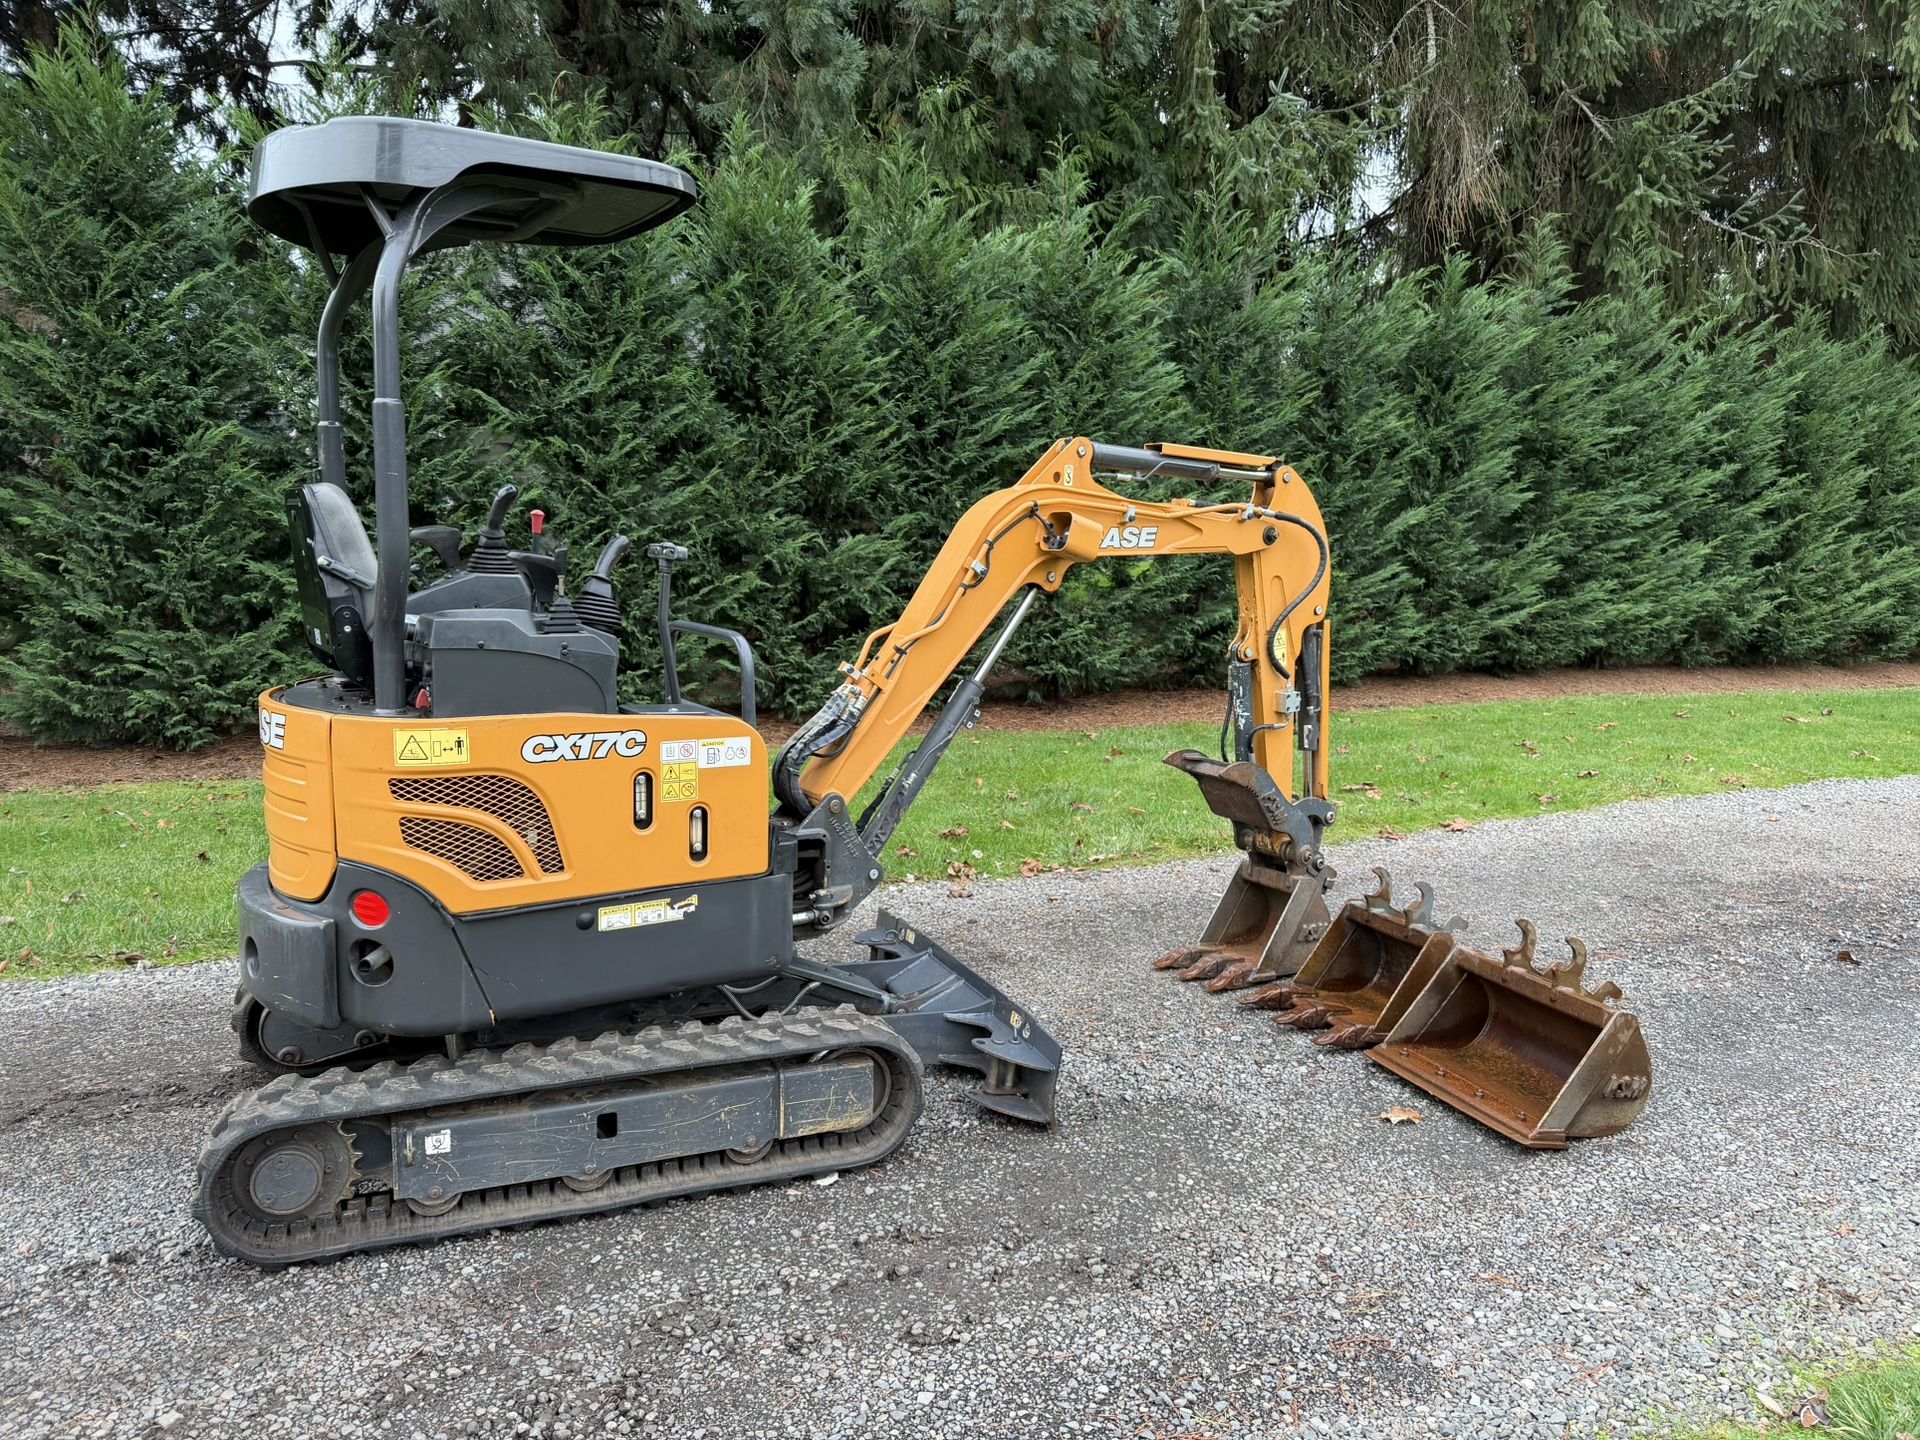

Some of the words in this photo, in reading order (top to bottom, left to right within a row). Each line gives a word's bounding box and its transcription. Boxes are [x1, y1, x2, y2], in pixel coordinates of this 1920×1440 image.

[1099, 526, 1158, 549] ASE
[259, 707, 287, 750] SE
[521, 729, 648, 763] CX17C
